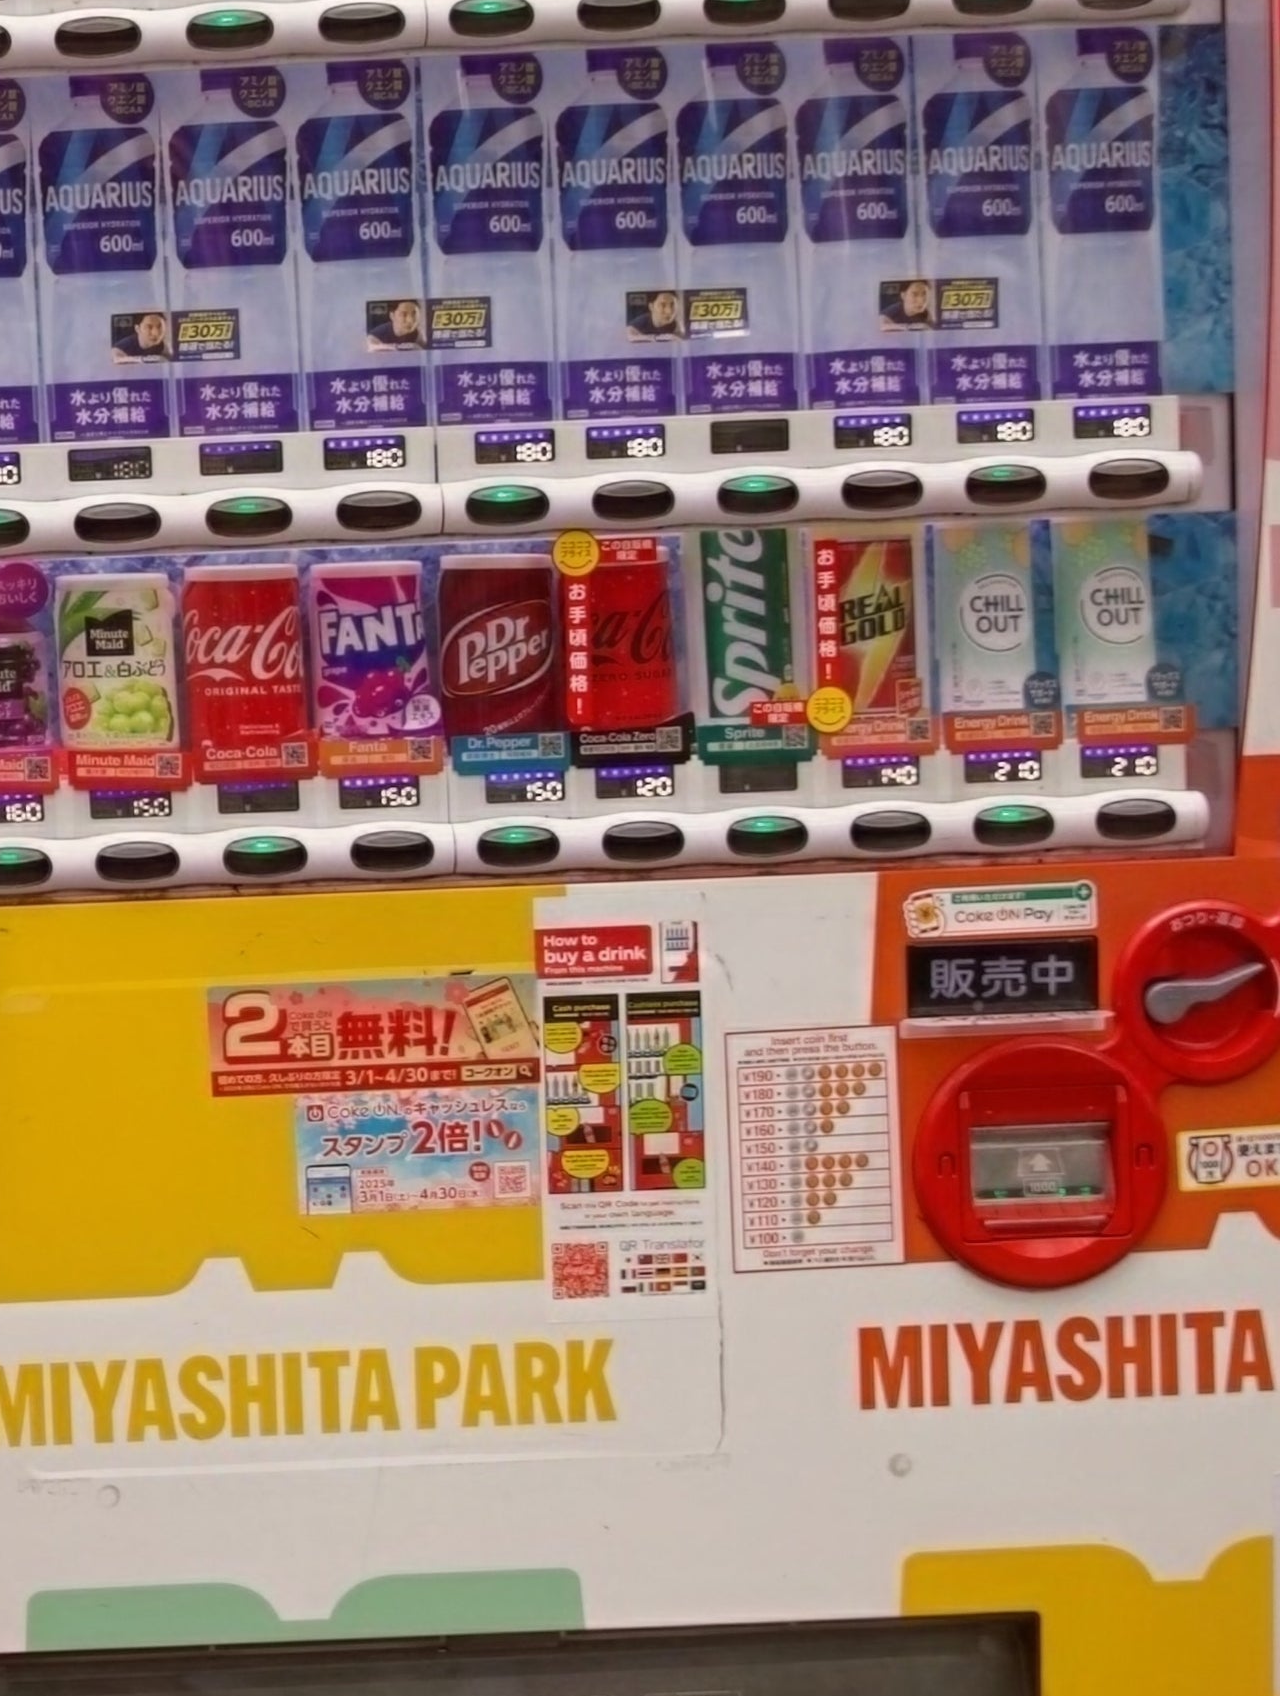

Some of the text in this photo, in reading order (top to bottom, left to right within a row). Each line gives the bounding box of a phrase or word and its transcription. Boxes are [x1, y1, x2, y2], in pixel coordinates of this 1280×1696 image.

[969, 594, 1025, 615] CHILL
[817, 548, 837, 681] お手頃価格!
[483, 613, 530, 648] Dr
[712, 527, 778, 719] Sprite
[975, 613, 1021, 634] OUT
[89, 628, 130, 643] Minute
[94, 639, 126, 650] Maid
[567, 582, 588, 716] お手頃価格!
[456, 626, 550, 686] Pepper
[204, 683, 302, 697] ORIGINAL TASTE
[724, 725, 766, 741] Sprite
[205, 745, 278, 761] Coca-Cola
[348, 740, 388, 753] Fanta
[954, 909, 994, 924] Coke
[1023, 907, 1054, 925] Pay
[543, 934, 598, 948] How to
[544, 946, 647, 966] buy a drink
[929, 954, 1076, 1000] 販売中
[336, 1006, 457, 1061] 無料!
[287, 1034, 334, 1060] 本目
[745, 1124, 776, 1137] ¥160
[746, 1142, 777, 1155] ¥150
[746, 1160, 778, 1173] ¥140
[1246, 1158, 1278, 1178] OK
[358, 1179, 396, 1190] 2025年
[747, 1178, 778, 1191] ¥130
[1028, 1181, 1057, 1194] 1000
[748, 1196, 779, 1209] ¥120
[748, 1214, 779, 1227] ¥110
[620, 1237, 705, 1252] QR Translator
[749, 1232, 780, 1245] ¥100
[858, 1308, 1275, 1411] MIYASHITA
[412, 1338, 618, 1430] PARK
